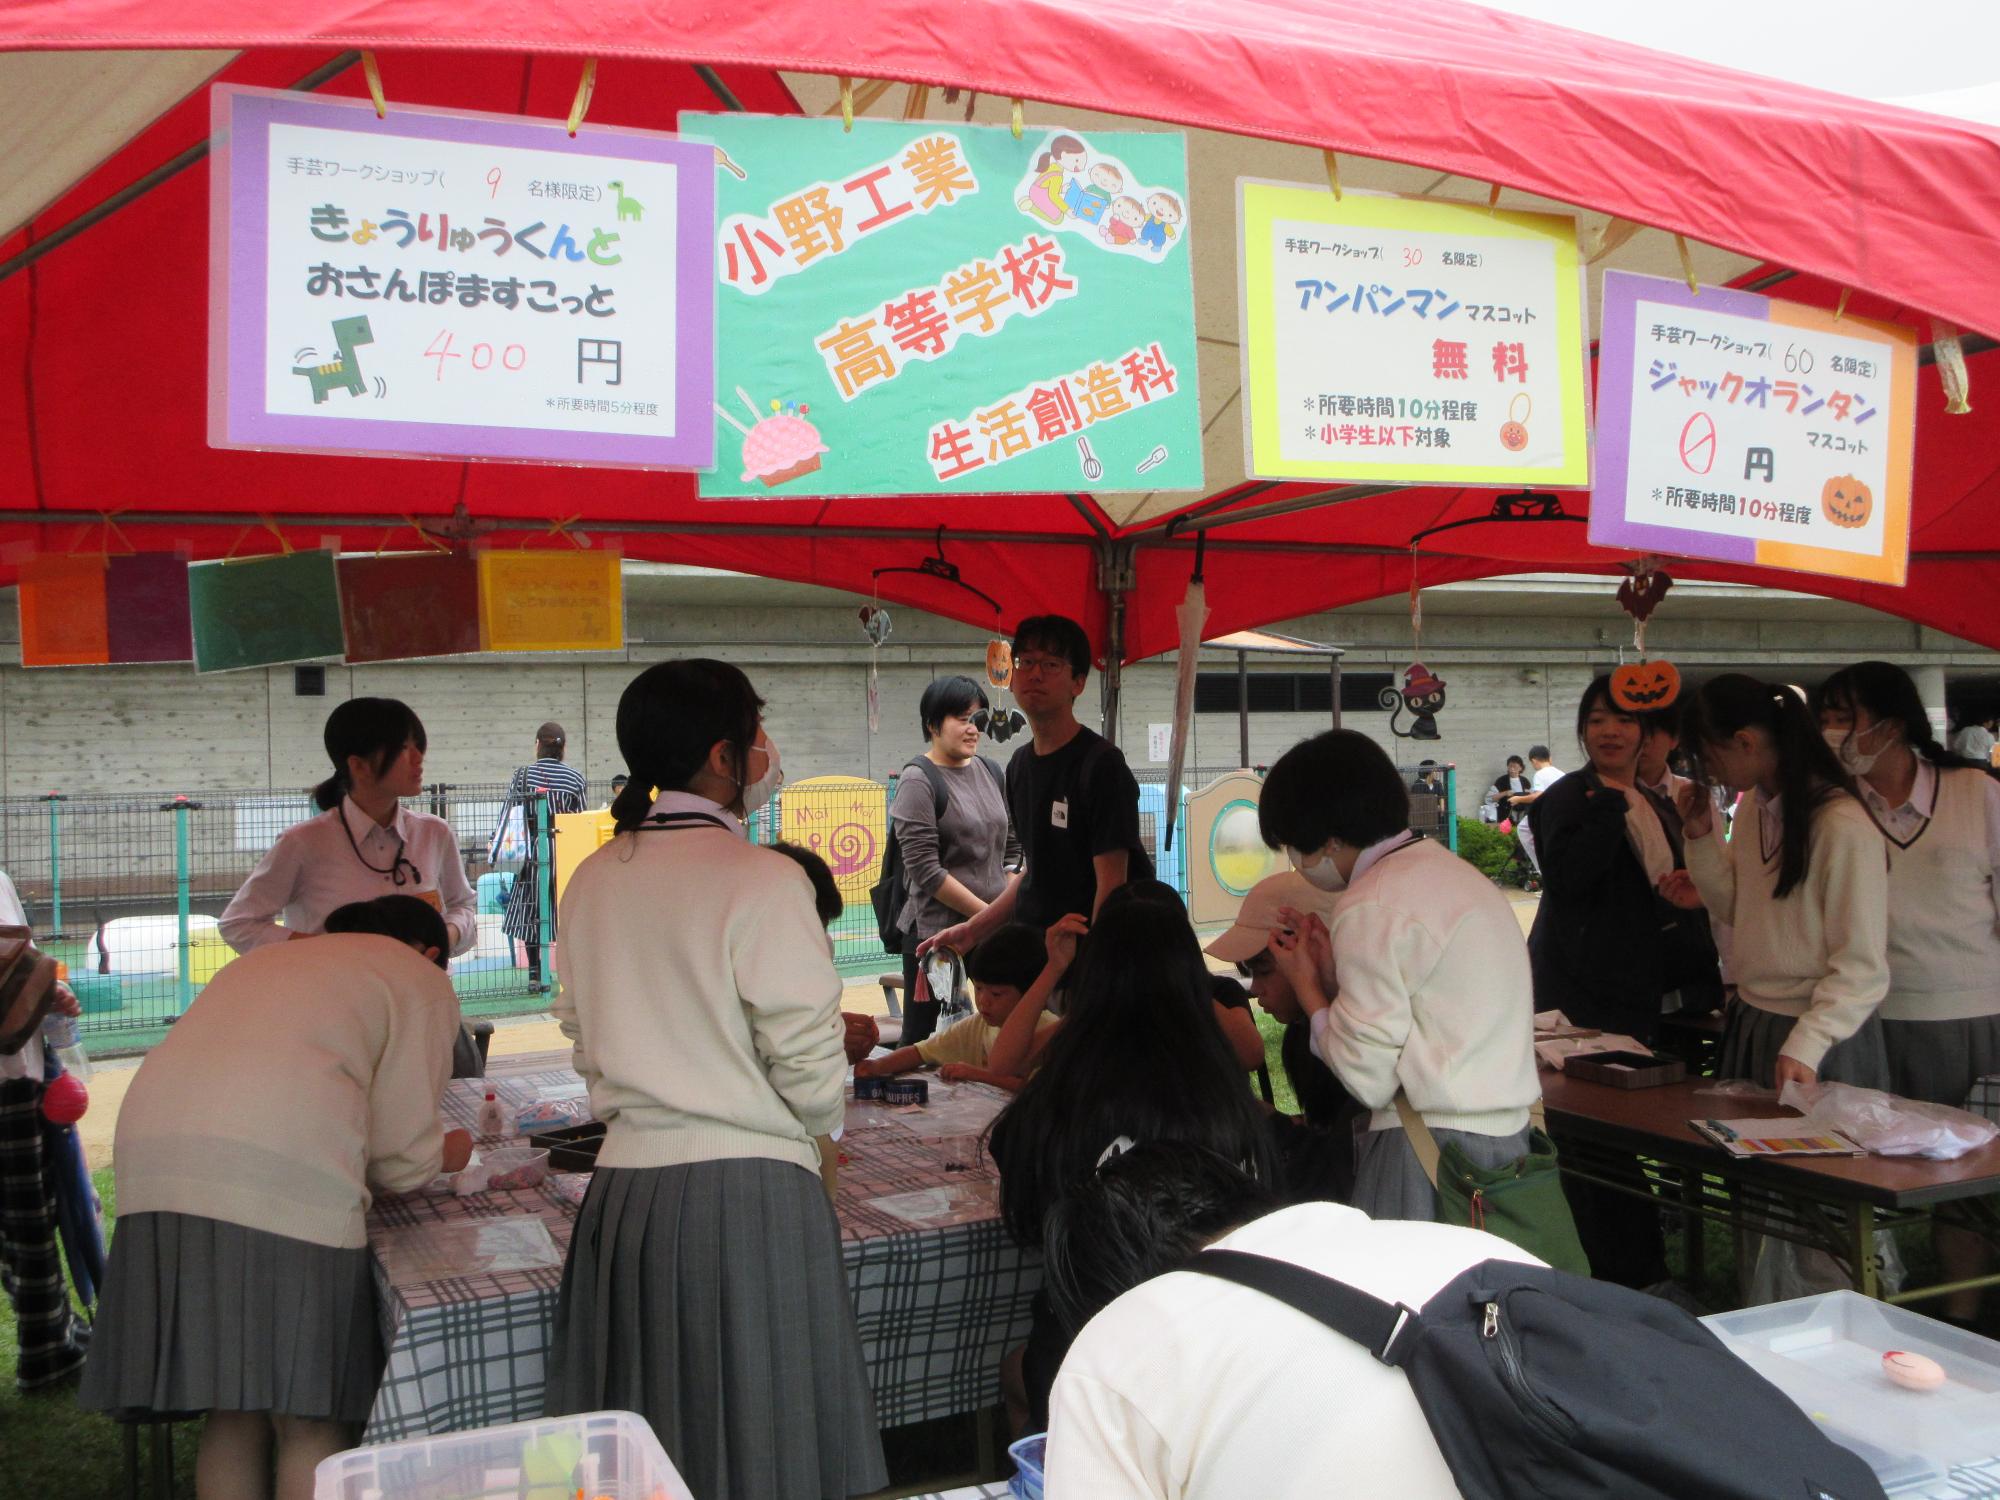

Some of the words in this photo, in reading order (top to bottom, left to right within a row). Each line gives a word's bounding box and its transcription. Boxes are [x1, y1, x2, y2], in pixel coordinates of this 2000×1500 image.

[486, 167, 500, 197] 9
[311, 203, 621, 264] きょうりゅうくんと
[724, 137, 973, 283] 小野工業
[1402, 248, 1423, 267] 30
[307, 262, 615, 316] おさんぽますこっと
[819, 236, 1071, 395] 高等学校
[1296, 279, 1459, 319] アンパンマン
[1464, 305, 1537, 324] マスコット
[425, 330, 525, 380] 400
[578, 338, 620, 384] 円
[1784, 343, 1813, 373] 60
[930, 344, 1175, 479] 生活創造科
[1649, 359, 1876, 424] ジャックオランタン
[1679, 412, 1715, 474] 0
[1744, 447, 1773, 482] 円
[1806, 431, 1867, 455] マスコット
